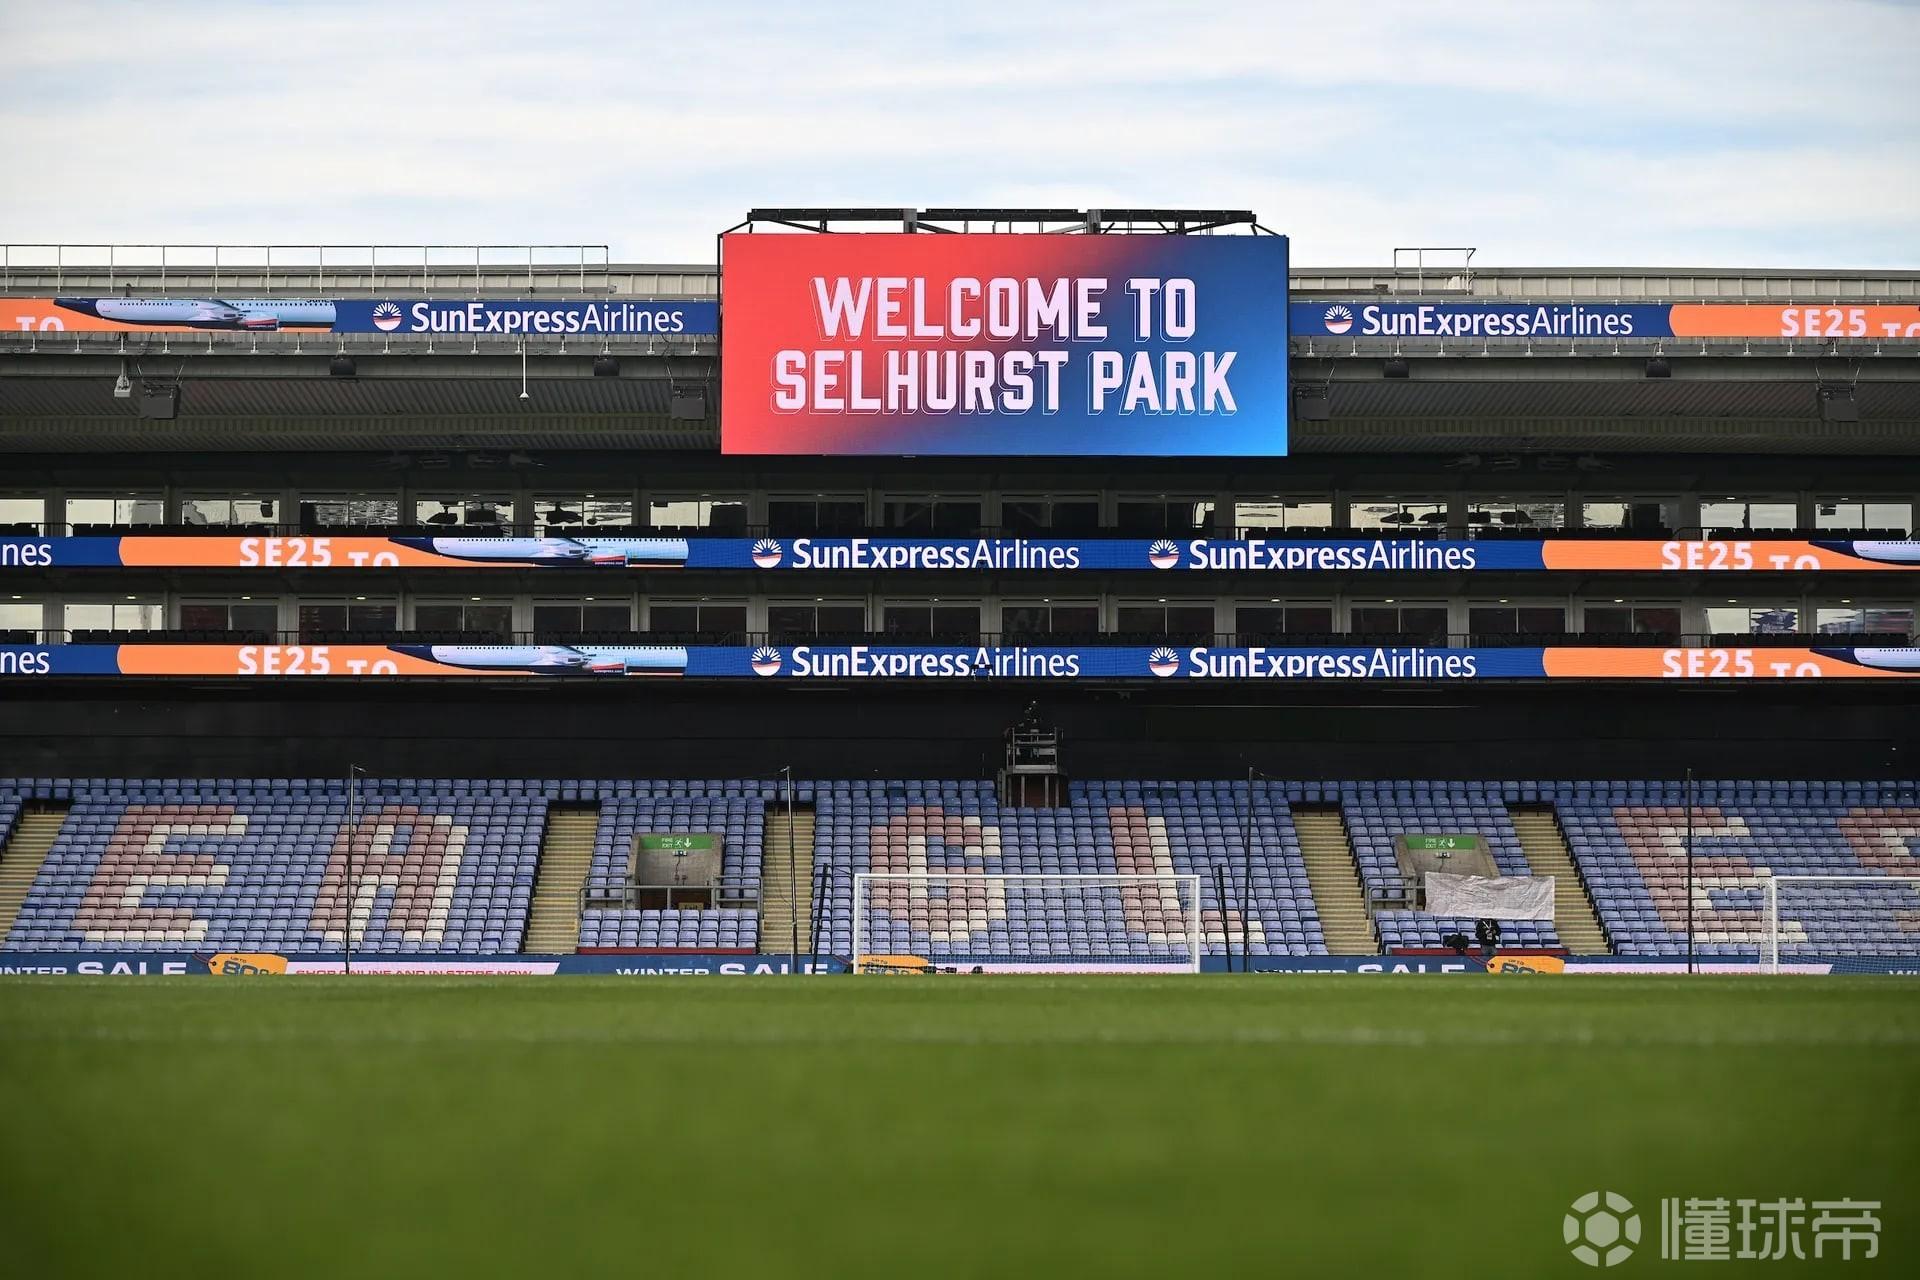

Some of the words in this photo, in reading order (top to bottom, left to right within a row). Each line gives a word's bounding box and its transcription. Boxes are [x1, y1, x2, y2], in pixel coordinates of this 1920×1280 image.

[811, 277, 1108, 340] WELCOME
[1126, 278, 1196, 340] TO
[1781, 309, 1867, 337] SE25
[772, 350, 1069, 413] SELHURST
[1089, 351, 1237, 413] PARK
[2, 543, 52, 566] nes
[239, 538, 332, 567] SE25
[1661, 541, 1754, 570] SE25
[0, 651, 50, 674] nes
[238, 646, 331, 675] SE25
[1662, 649, 1754, 678] SE25
